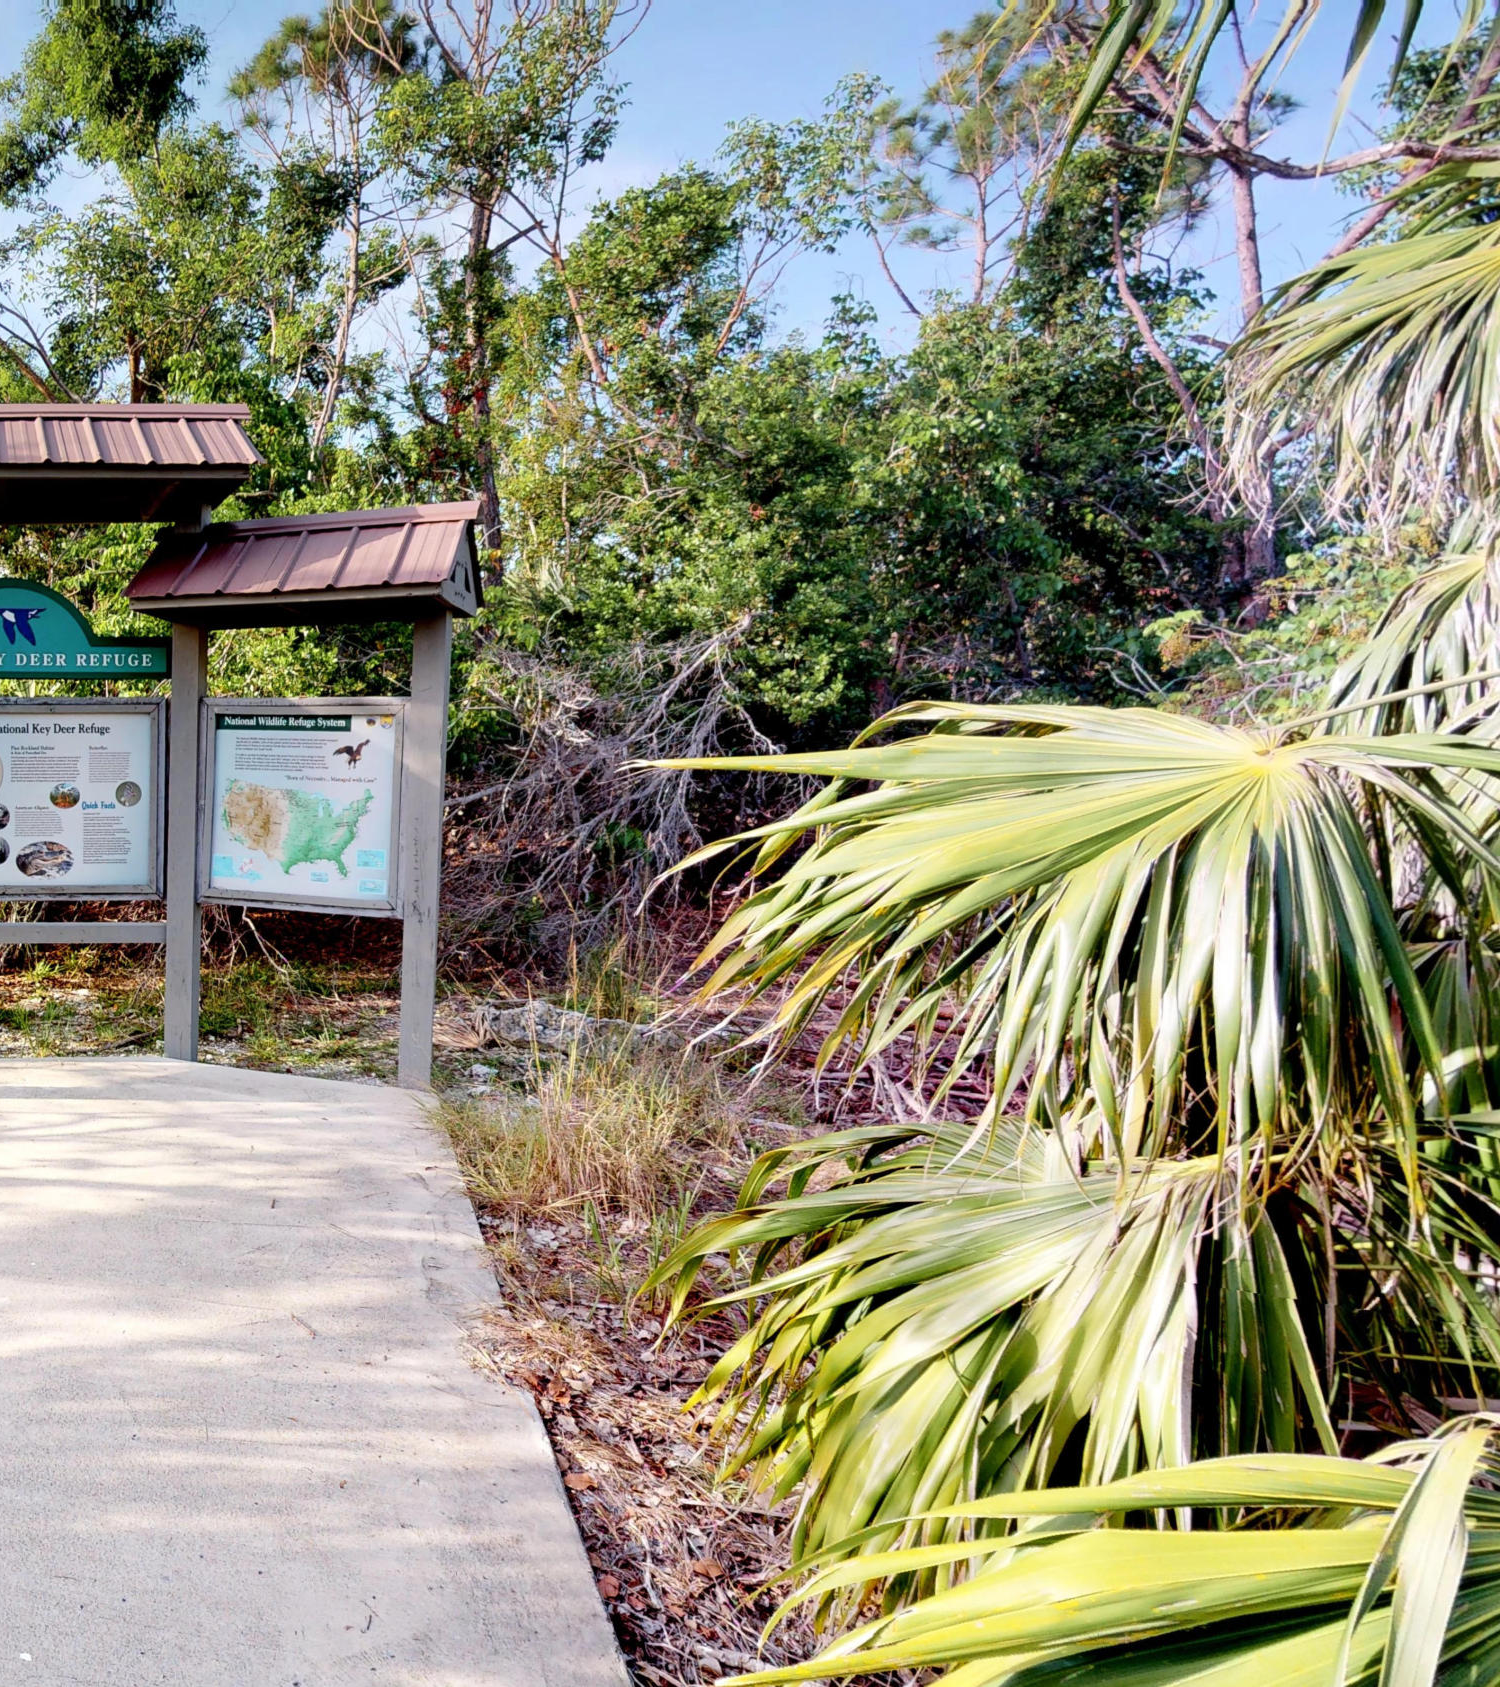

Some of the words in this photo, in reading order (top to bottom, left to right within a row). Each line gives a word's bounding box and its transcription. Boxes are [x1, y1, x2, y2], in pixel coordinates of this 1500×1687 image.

[15, 654, 67, 667] DEER
[76, 654, 153, 668] REFUGE
[224, 716, 257, 726] National
[258, 717, 287, 727] Wildlife
[288, 717, 316, 728] Refuge
[317, 717, 346, 728] System
[32, 723, 51, 736] Key
[53, 723, 76, 735] Deer
[78, 723, 111, 736] Refuge
[82, 801, 98, 810] Quick
[100, 801, 116, 809] Facts
